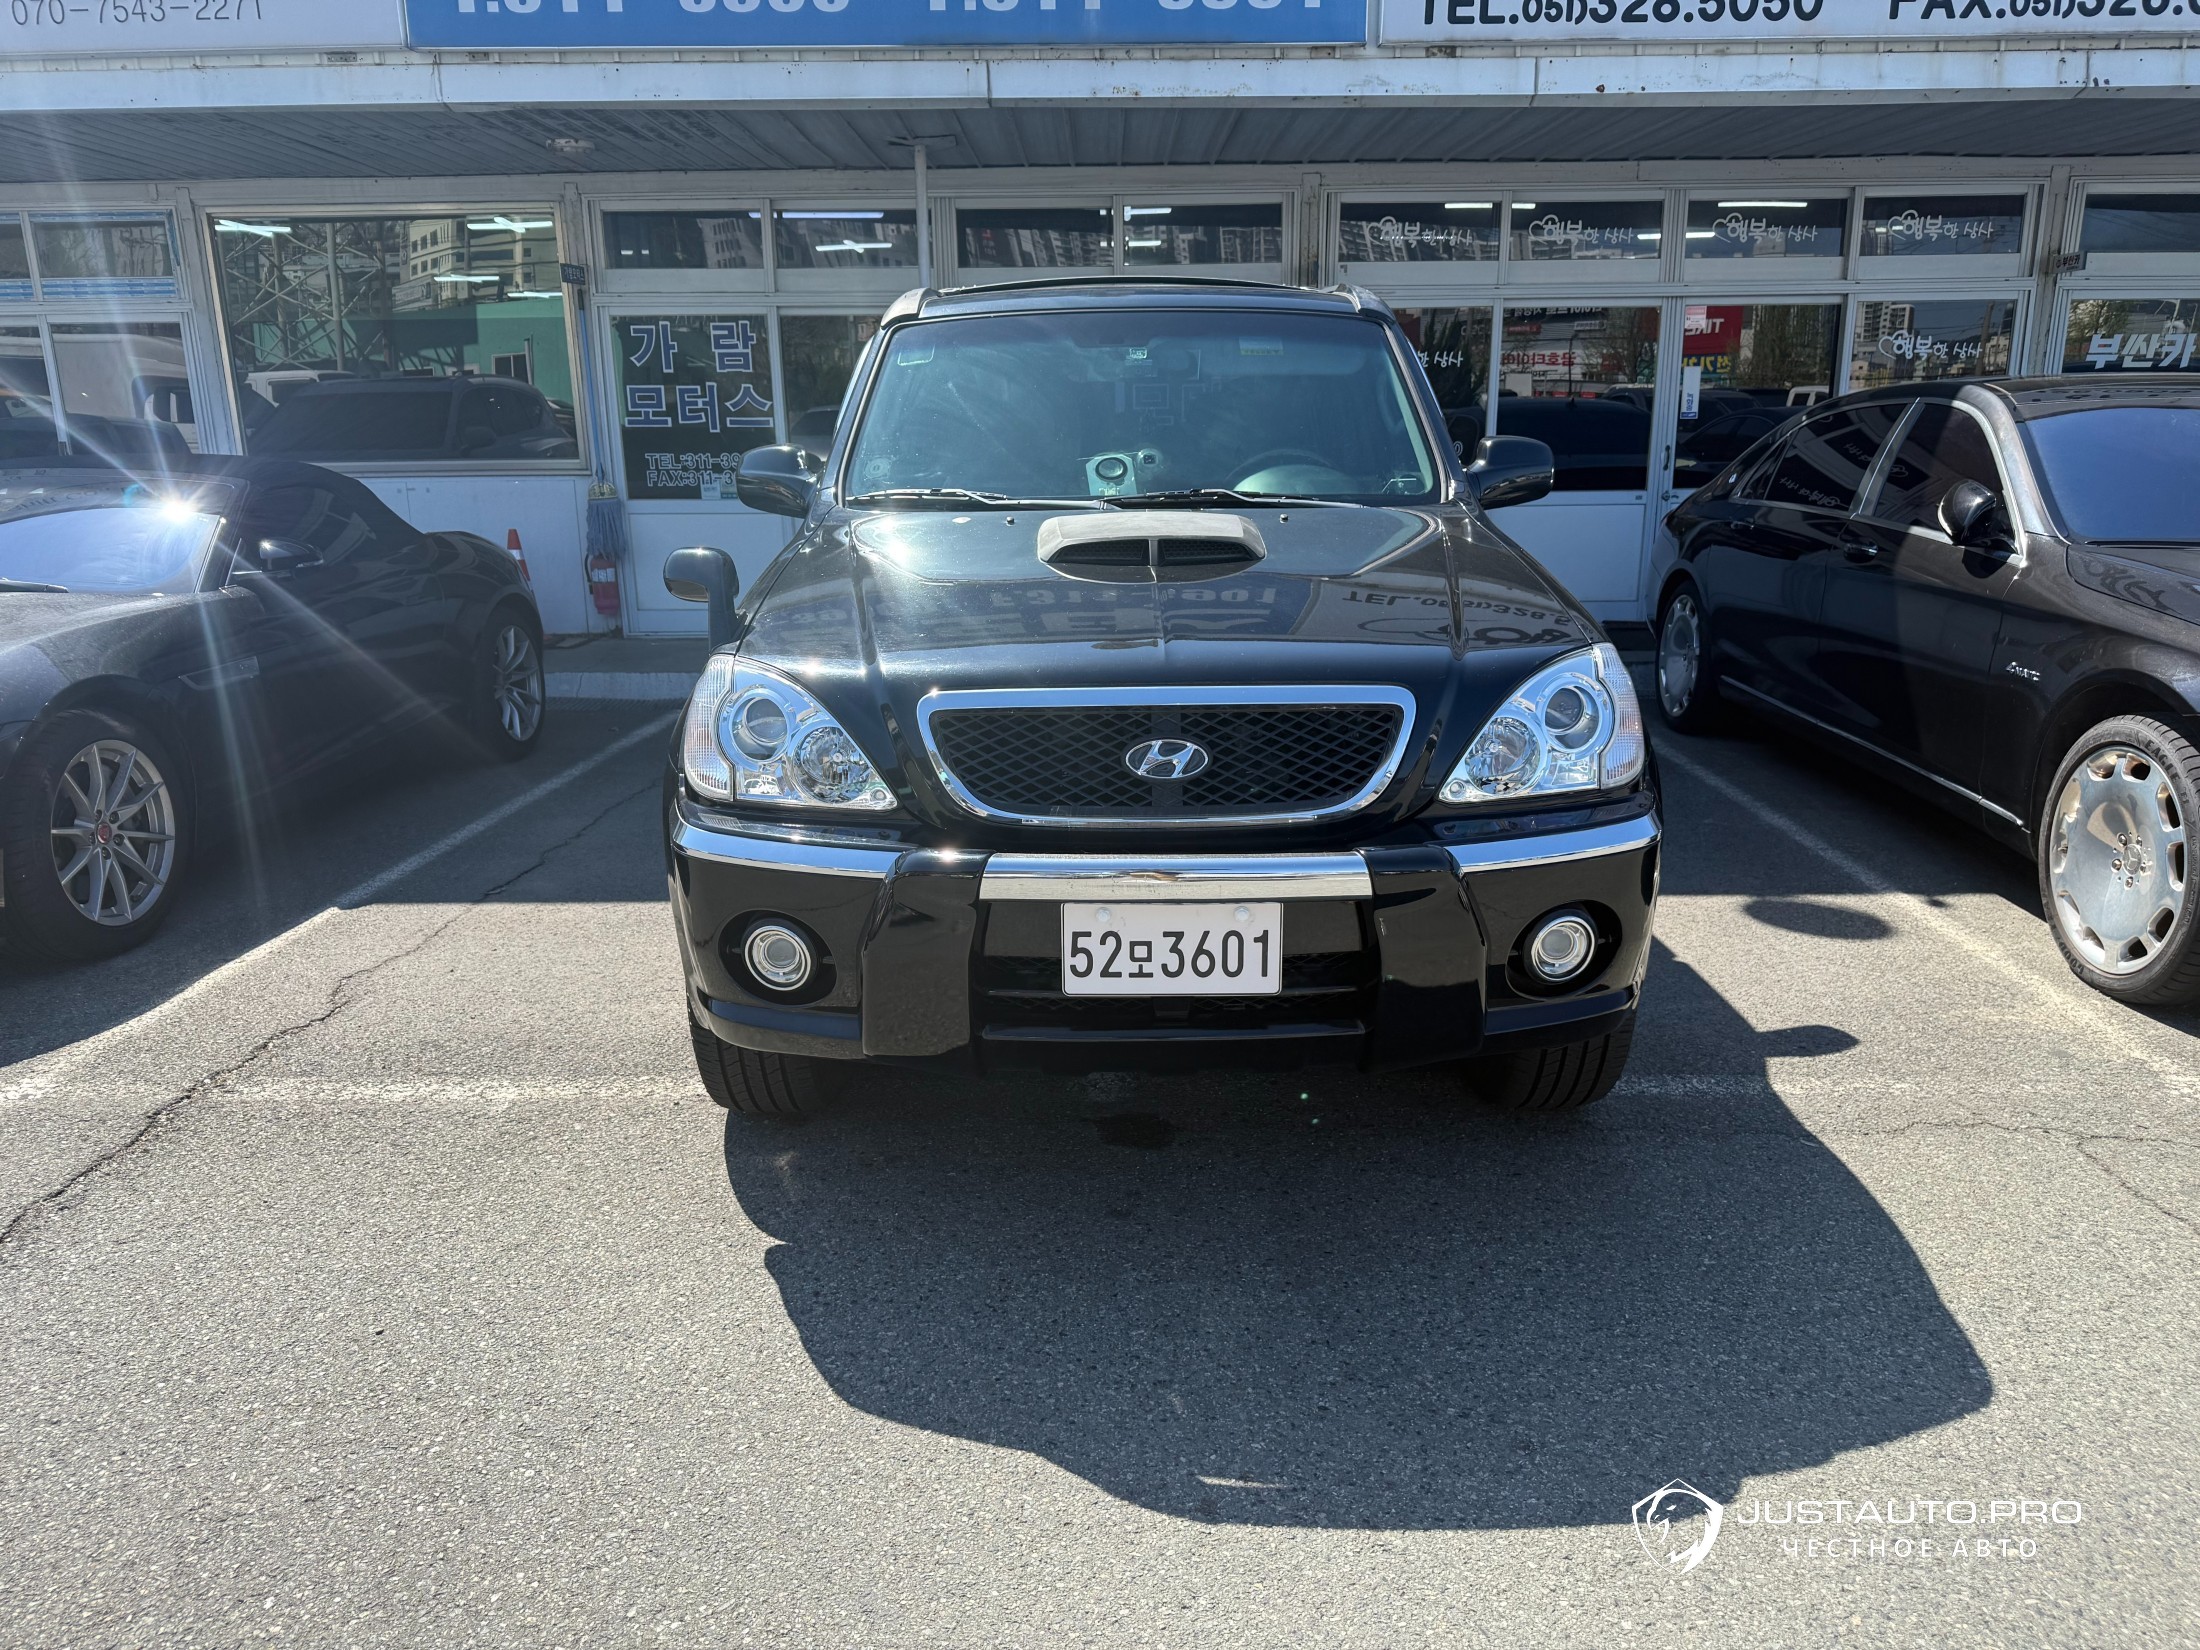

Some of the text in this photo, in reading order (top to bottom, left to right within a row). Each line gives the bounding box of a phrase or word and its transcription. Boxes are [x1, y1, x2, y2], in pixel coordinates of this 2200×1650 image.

[1726, 217, 1818, 244] 행복한 상사
[1902, 214, 1994, 241] 행복한 상사
[1433, 351, 1464, 368] 상사
[1892, 333, 1983, 361] 행복한 상사
[624, 381, 774, 433] 모터스
[646, 470, 737, 487] FAX:311-3
[1069, 929, 1269, 979] 52모3601
